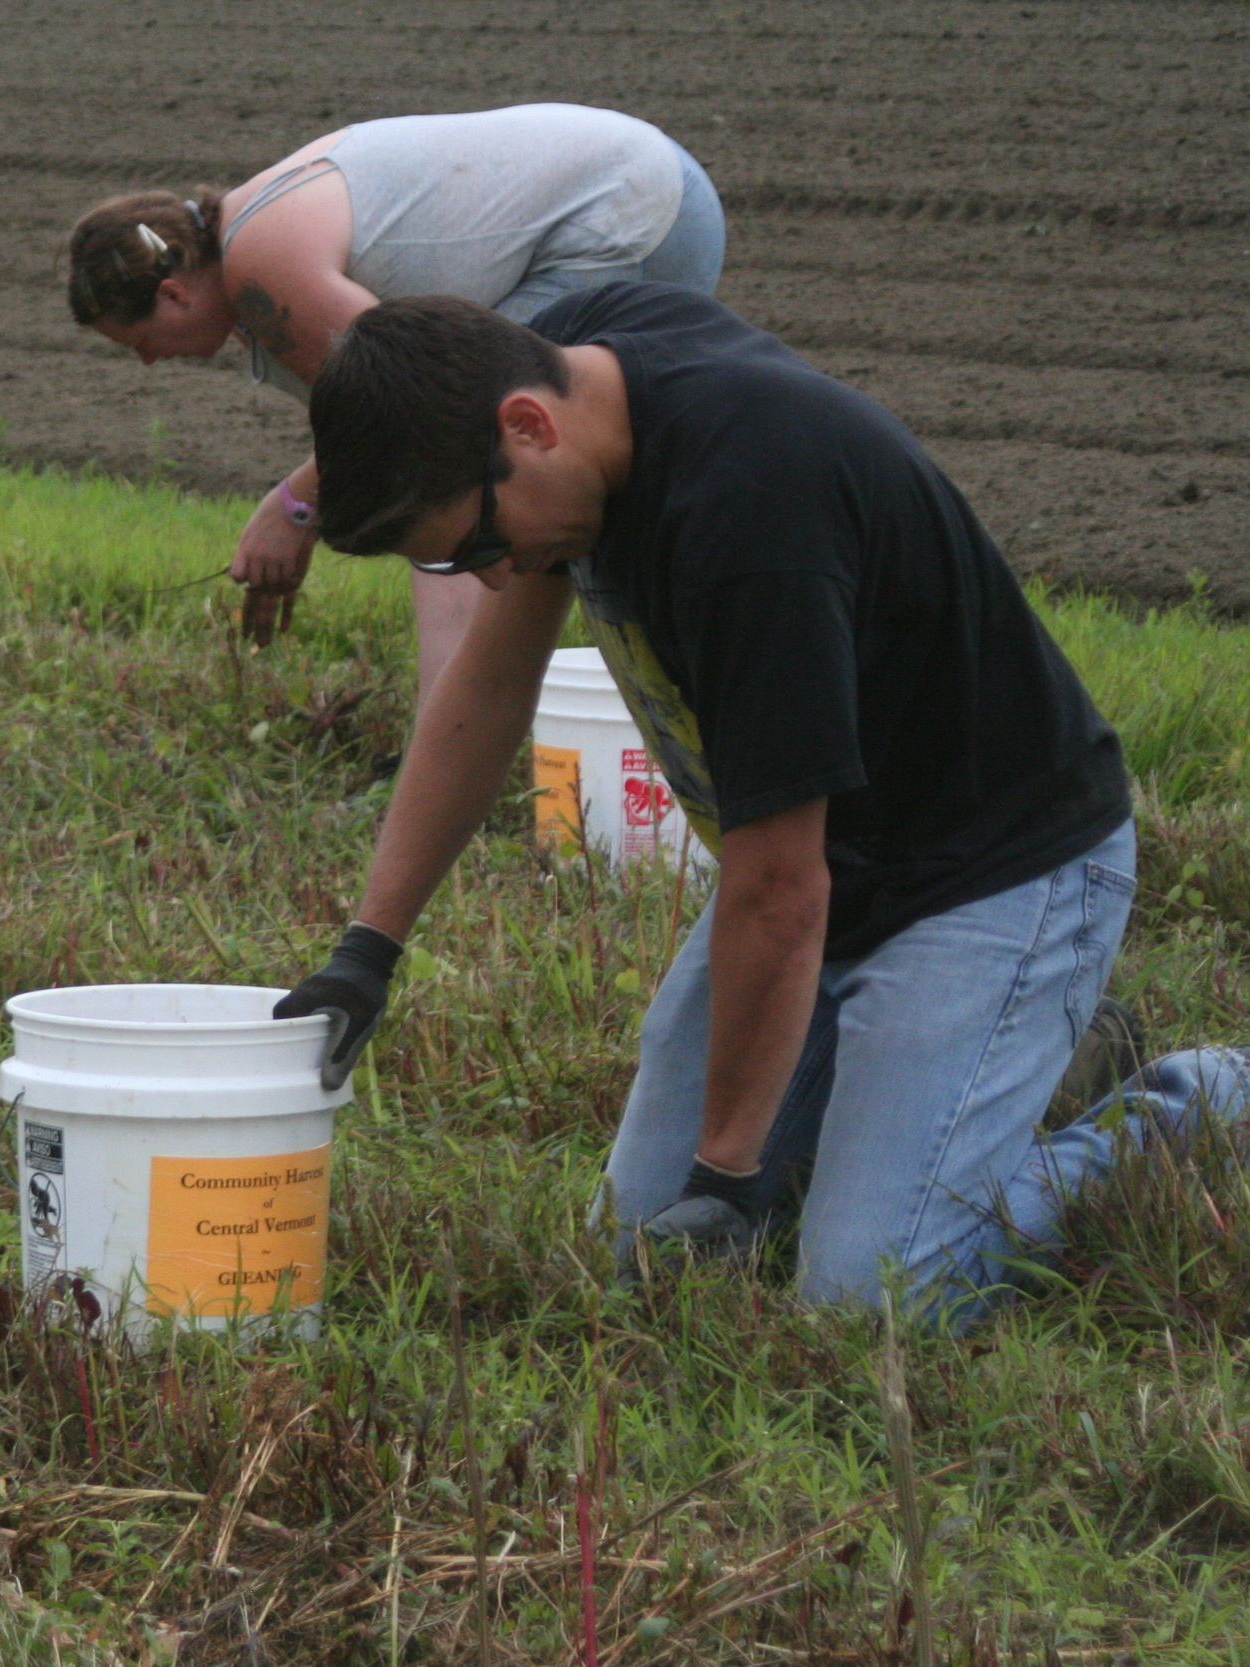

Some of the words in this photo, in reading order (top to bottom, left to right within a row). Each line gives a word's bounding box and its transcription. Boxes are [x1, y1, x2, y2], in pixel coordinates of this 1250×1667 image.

[181, 1172, 282, 1191] Community
[263, 1197, 275, 1209] of
[196, 1219, 260, 1236] Central
[264, 1214, 316, 1232] Vermont
